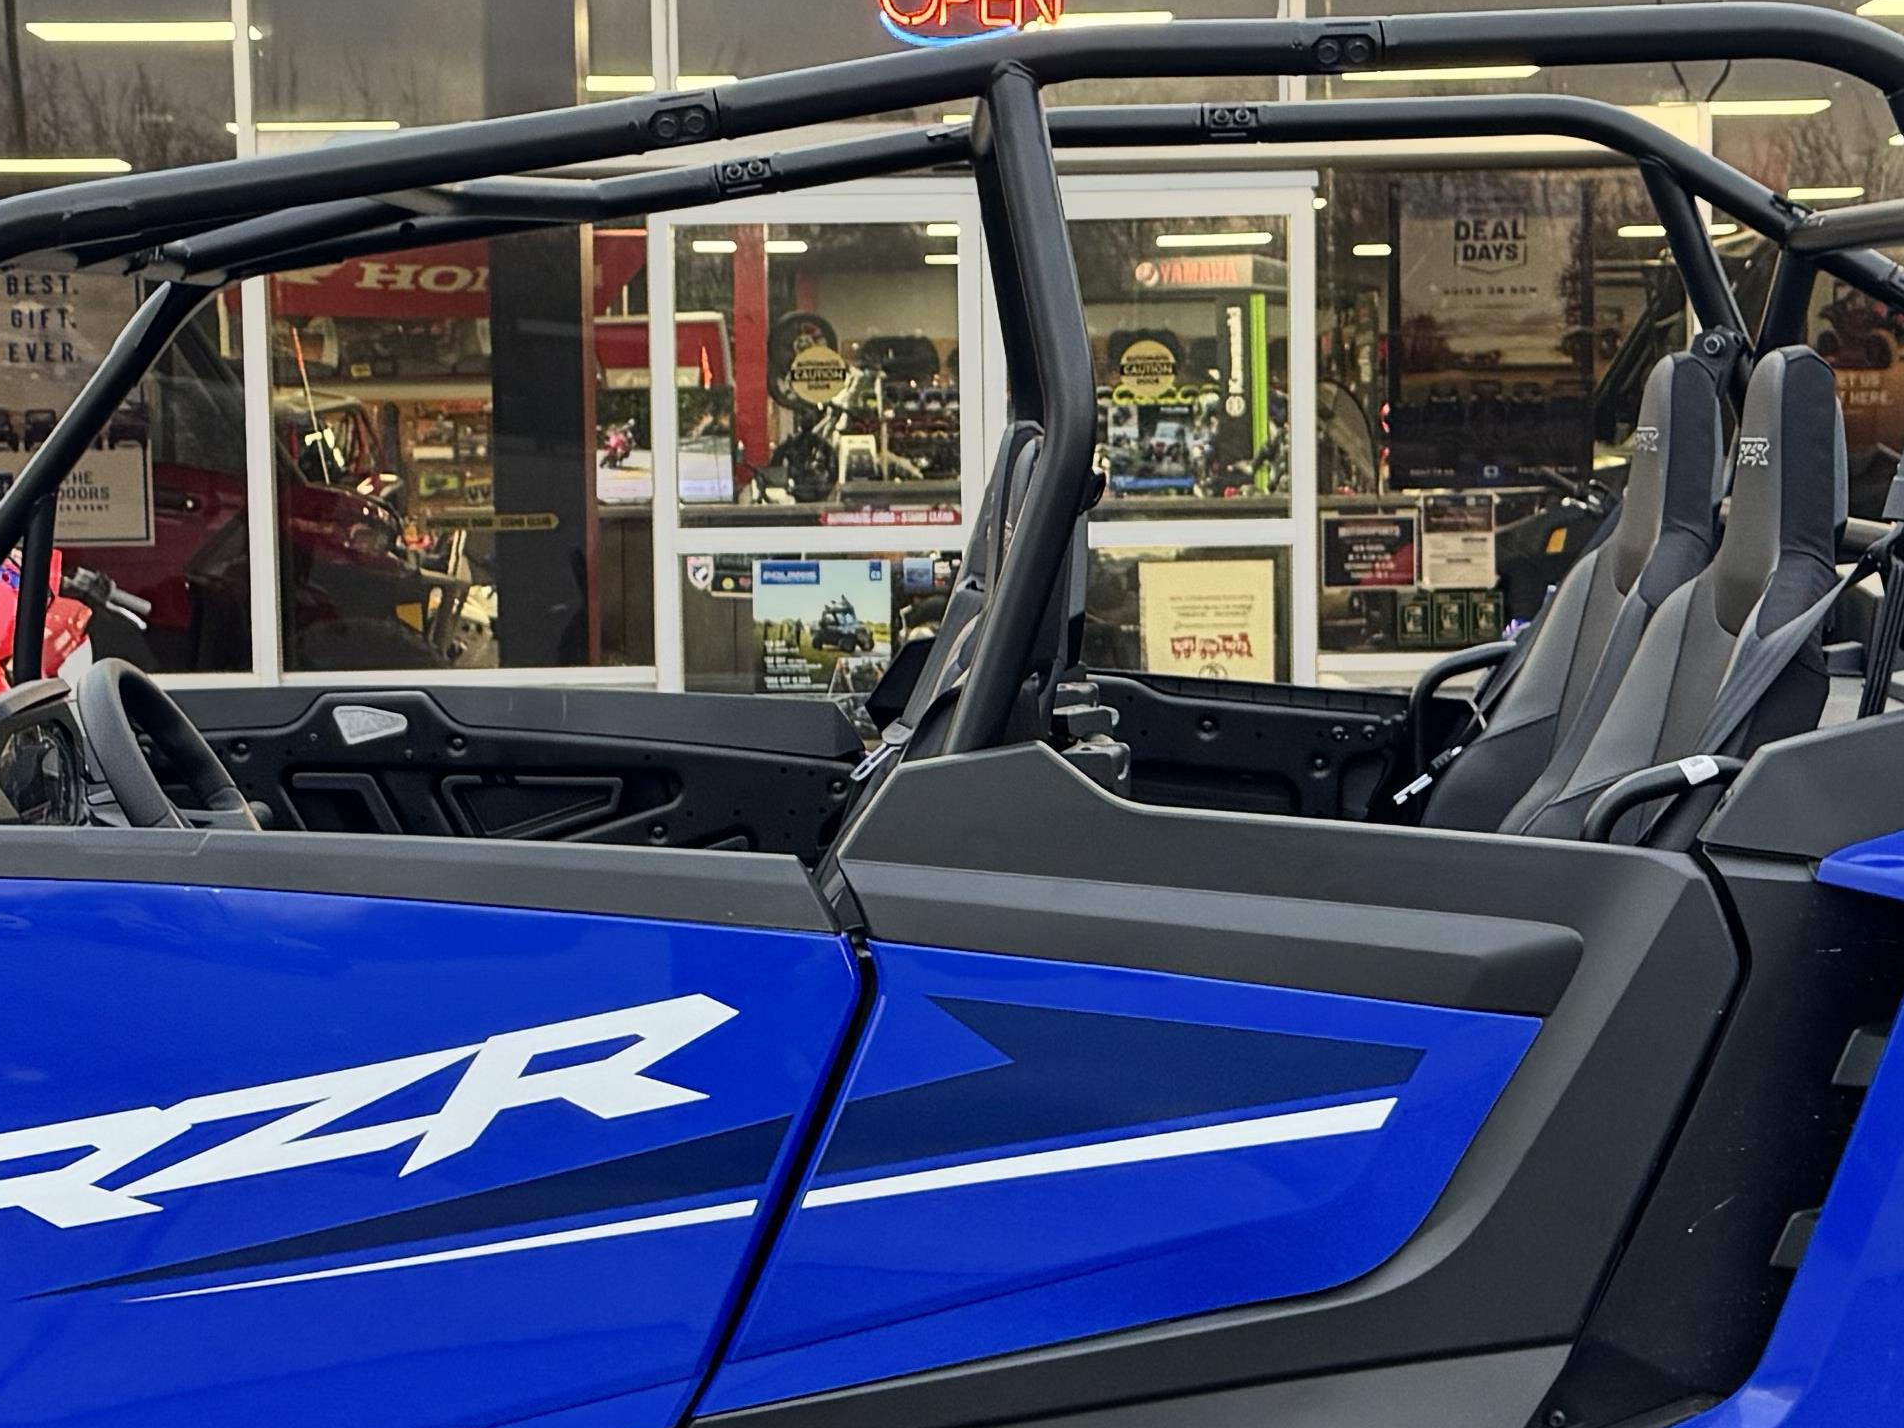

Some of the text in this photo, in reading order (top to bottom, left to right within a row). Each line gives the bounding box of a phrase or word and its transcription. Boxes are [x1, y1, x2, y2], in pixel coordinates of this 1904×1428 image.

[1454, 218, 1527, 242] DEAL
[1461, 244, 1519, 263] DAYS
[1159, 260, 1238, 285] YAMAHA
[6, 273, 80, 296] BEST.
[10, 310, 77, 330] GIFT.
[9, 343, 81, 363] EVER.
[793, 369, 845, 381] CAUTION
[1123, 363, 1174, 375] CAUTION
